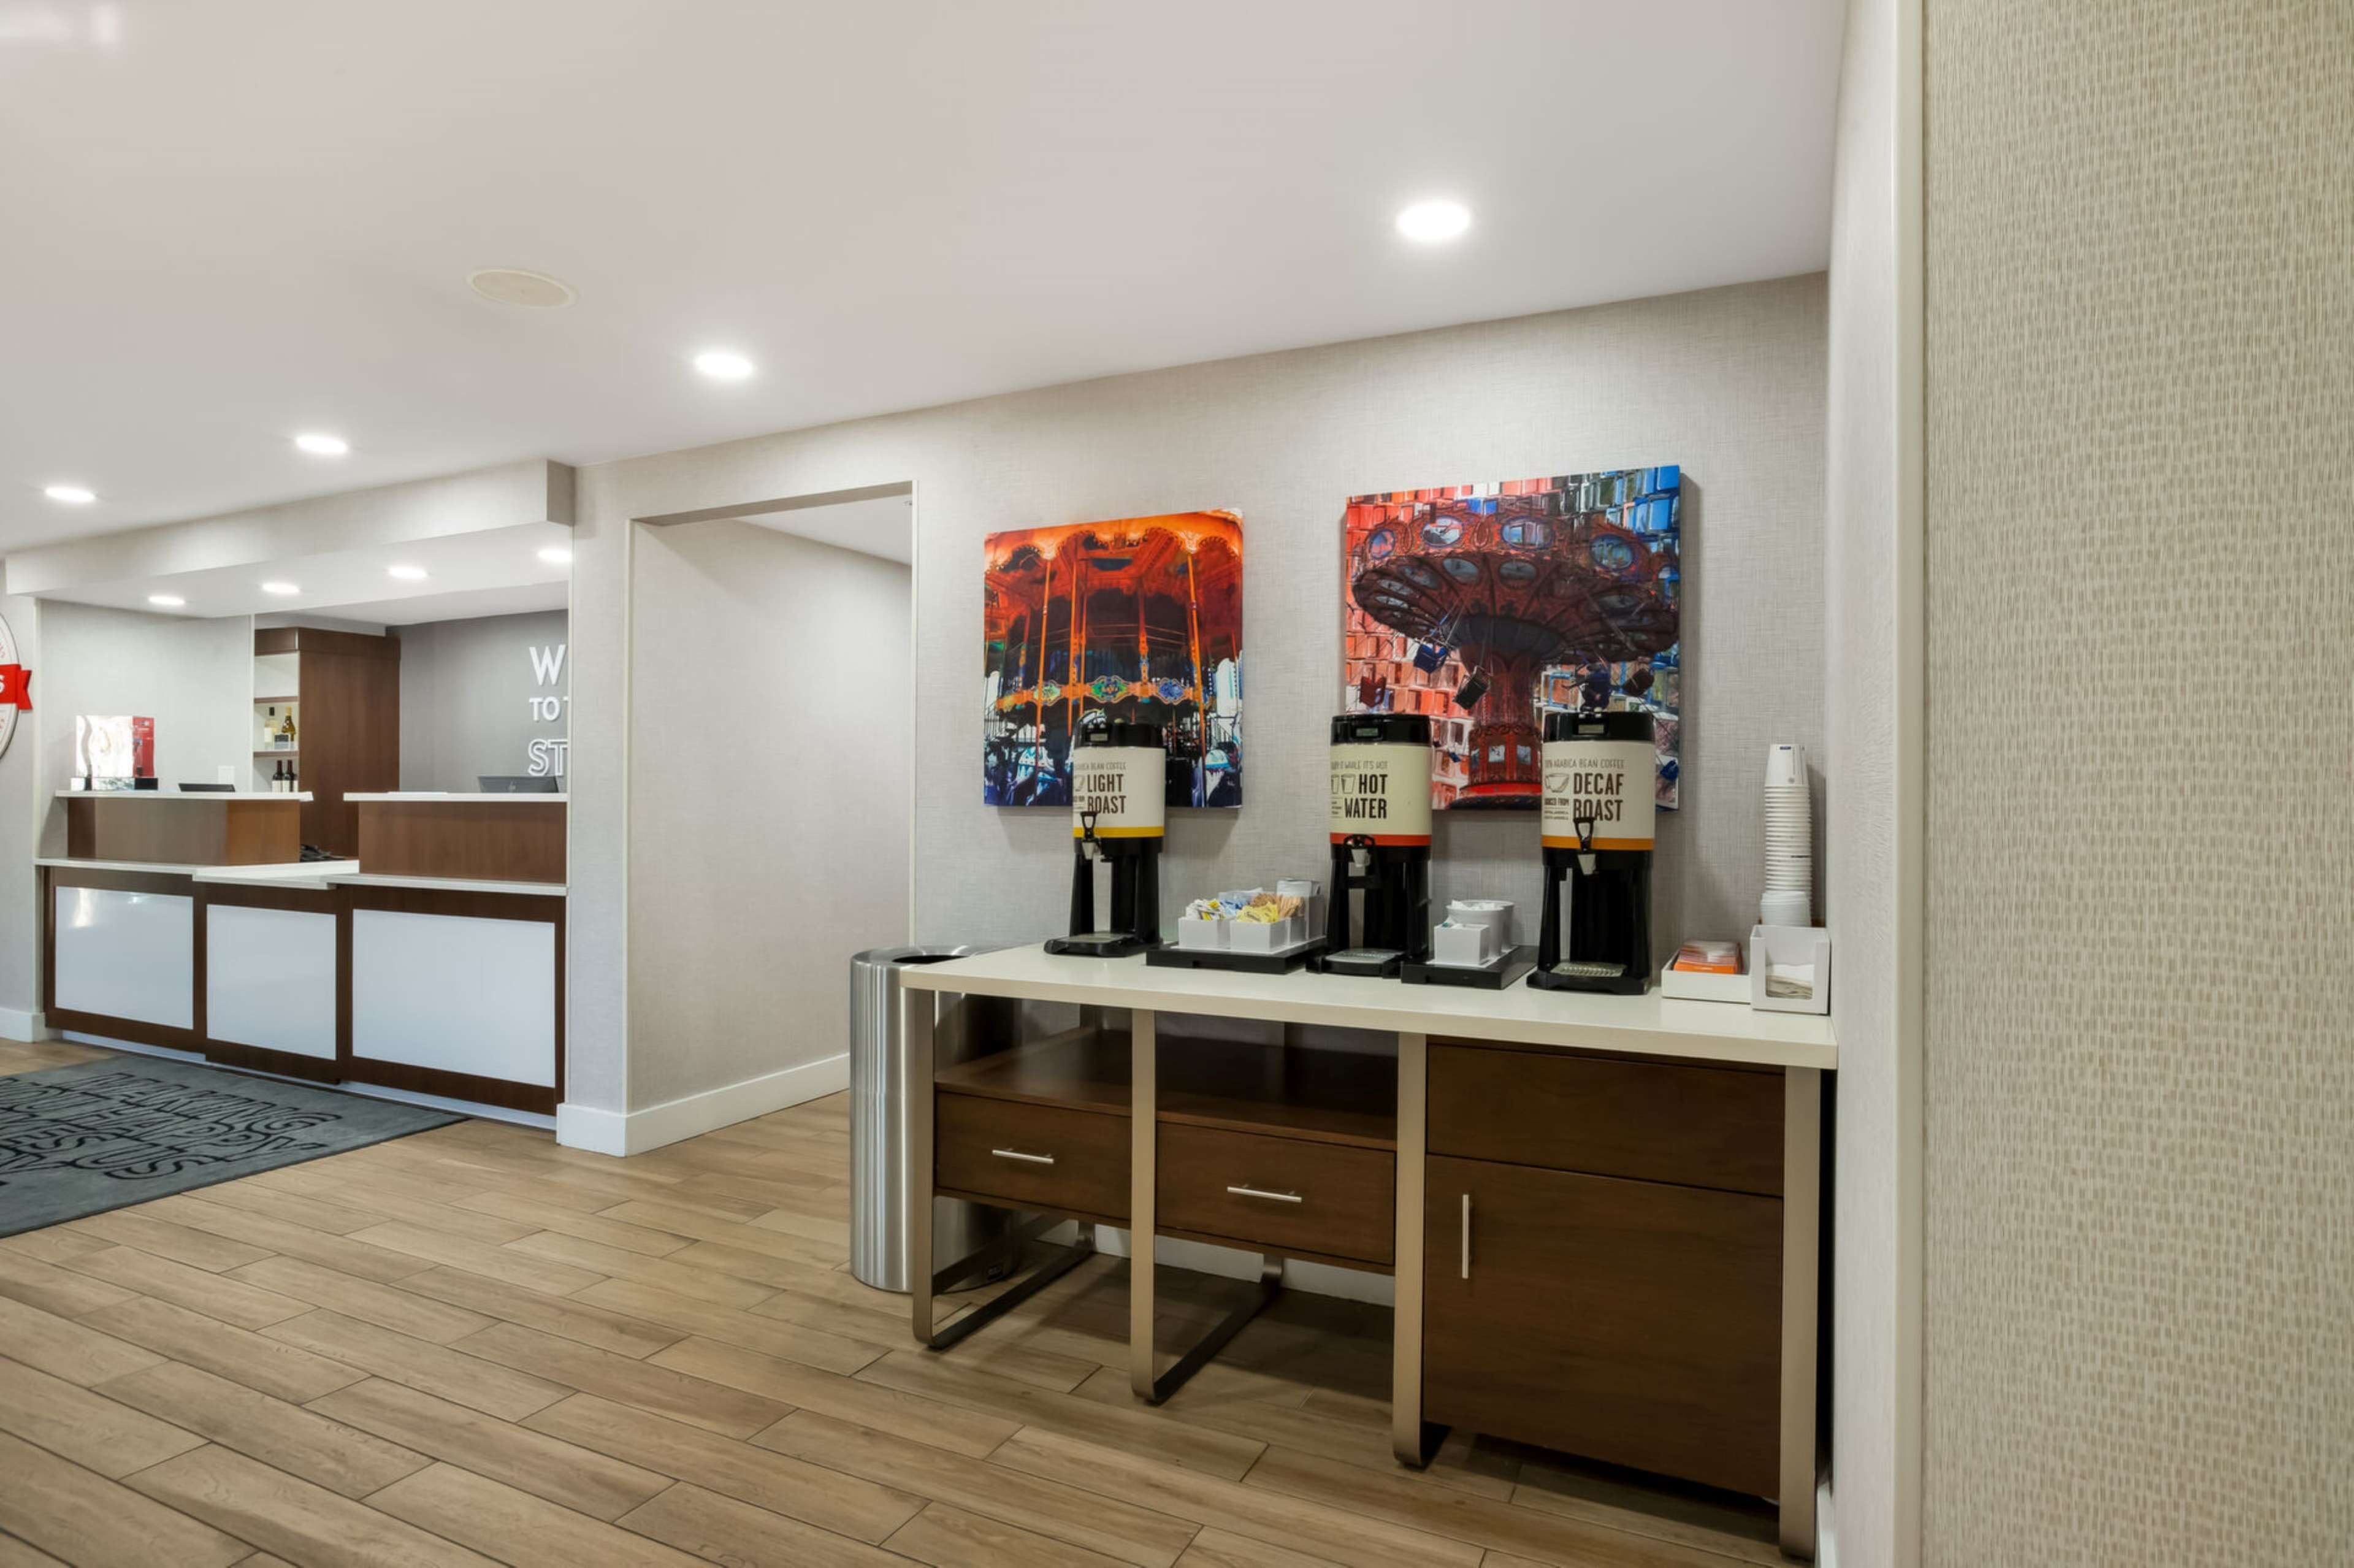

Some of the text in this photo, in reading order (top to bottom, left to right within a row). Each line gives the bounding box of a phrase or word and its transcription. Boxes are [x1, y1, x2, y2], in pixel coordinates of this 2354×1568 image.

[529, 696, 560, 721] TO
[1087, 774, 1124, 793] LIGHT
[1359, 774, 1388, 794] HOT
[1573, 773, 1624, 795] DECAF
[1087, 795, 1127, 814] ROAST
[1344, 797, 1388, 819] WATER
[1573, 798, 1624, 822] ROAST
